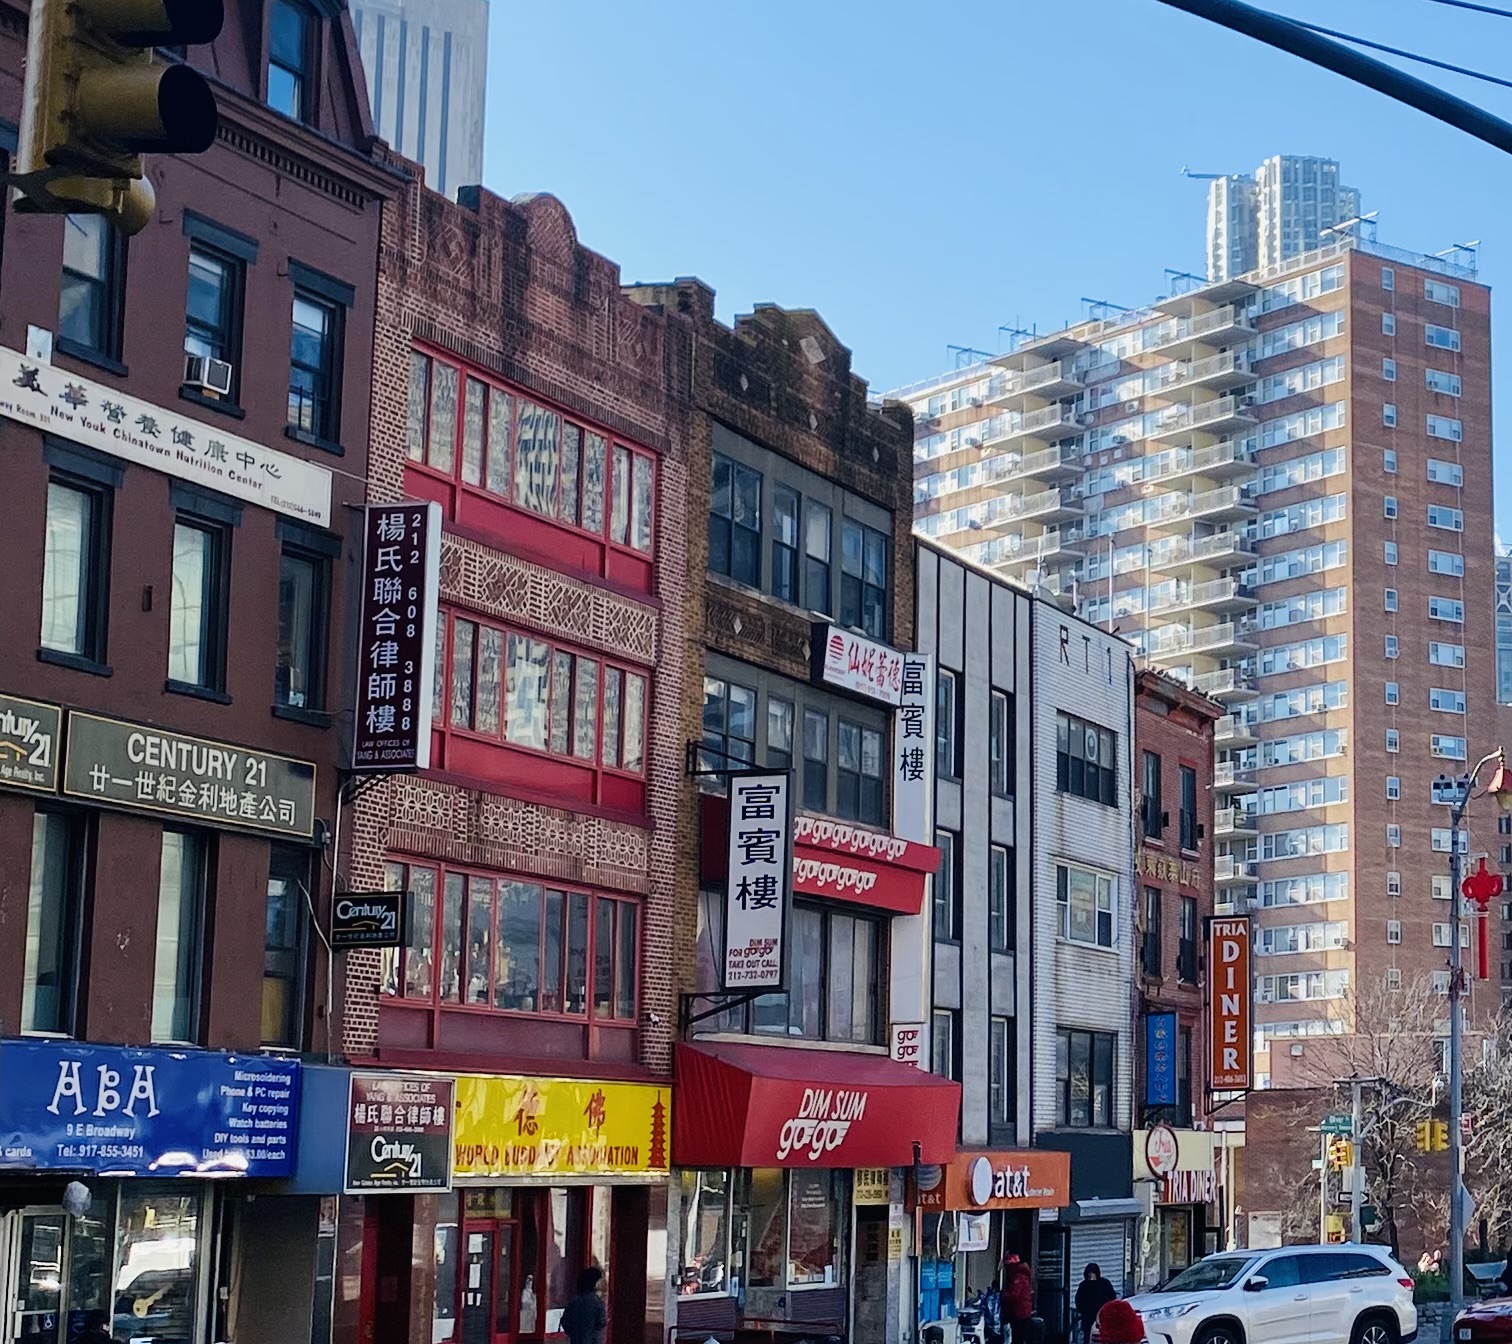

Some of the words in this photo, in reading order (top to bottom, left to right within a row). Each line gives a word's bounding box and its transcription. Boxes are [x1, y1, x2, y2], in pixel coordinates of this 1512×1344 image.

[50, 406, 74, 422] New
[113, 428, 171, 457] Chinatown
[176, 449, 223, 476] Nutrition
[411, 514, 421, 564] 212
[366, 513, 406, 735] 楊氏聯合律師樓
[406, 587, 417, 637] 608
[401, 661, 413, 731] 3888
[28, 733, 51, 768] 21
[127, 732, 238, 781] CENTURY
[244, 756, 266, 788] 21
[89, 763, 296, 826] 廿一世紀金利地產公司
[336, 900, 388, 920] Century
[380, 912, 396, 931] 21
[1214, 923, 1247, 937] TRIA
[746, 959, 760, 968] OUT
[1220, 940, 1241, 1071] DINER
[220, 1085, 246, 1097] Phone
[255, 1087, 266, 1097] PC
[267, 1088, 290, 1100] repair
[258, 1103, 289, 1116] copying
[798, 1088, 834, 1119] DIM
[834, 1091, 868, 1121] SUM
[66, 1123, 73, 1136] 9
[76, 1124, 83, 1135] E
[86, 1124, 136, 1140] Broadway
[214, 1132, 229, 1144] DIY
[230, 1133, 249, 1144] tools
[251, 1134, 266, 1144] and
[228, 1117, 253, 1128] Watch
[371, 1136, 415, 1163] Century
[409, 1153, 422, 1177] 21
[994, 1164, 1031, 1198] at&t
[1167, 1170, 1188, 1203] TRIA
[1190, 1169, 1216, 1203] DINER
